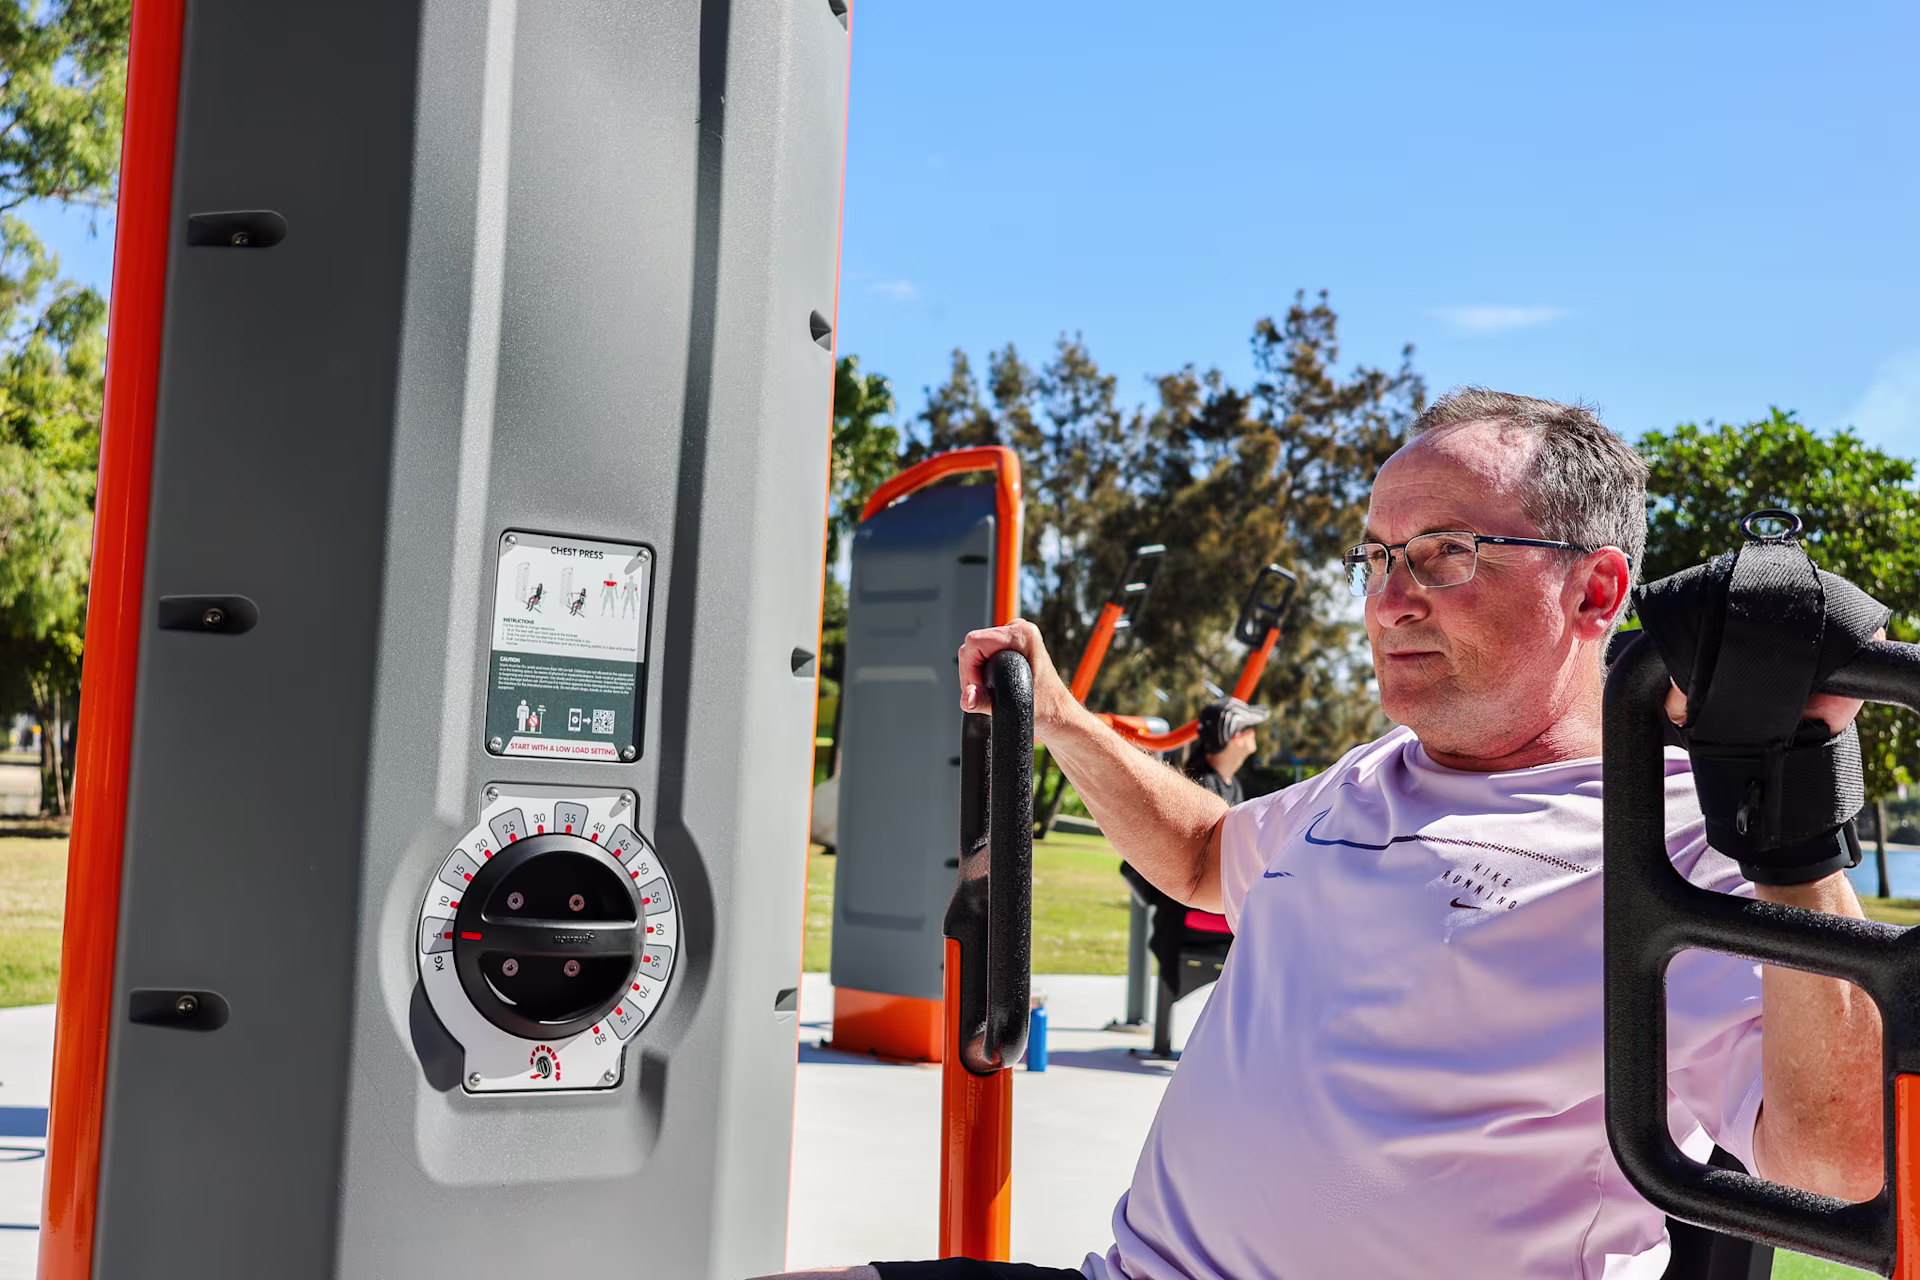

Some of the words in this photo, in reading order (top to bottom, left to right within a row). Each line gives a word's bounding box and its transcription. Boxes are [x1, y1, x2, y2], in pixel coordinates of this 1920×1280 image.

[550, 546, 577, 557] CHEST
[579, 550, 604, 560] PRESS
[503, 617, 535, 625] INSTRUCTIONS
[499, 655, 521, 663] CAUTION
[510, 742, 530, 750] START
[531, 744, 548, 752] WITH
[572, 747, 590, 755] LOAD
[591, 748, 616, 756] SETTING
[533, 813, 546, 824] 30
[564, 813, 577, 824] 35
[502, 820, 516, 834] 25
[592, 821, 606, 834] 40
[474, 838, 489, 852] 20
[618, 838, 631, 852] 45
[453, 865, 466, 877] 15
[637, 861, 650, 876] 50
[1471, 862, 1512, 888] NIKE
[1441, 870, 1518, 910] RUNNING
[439, 895, 450, 907] 10
[650, 891, 662, 905] 55
[432, 932, 443, 940] 5
[655, 923, 665, 936] 60
[433, 955, 446, 972] KG
[651, 954, 661, 969] 65
[638, 985, 651, 1000] 70
[618, 1012, 633, 1026] 75
[594, 1032, 608, 1046] 80
